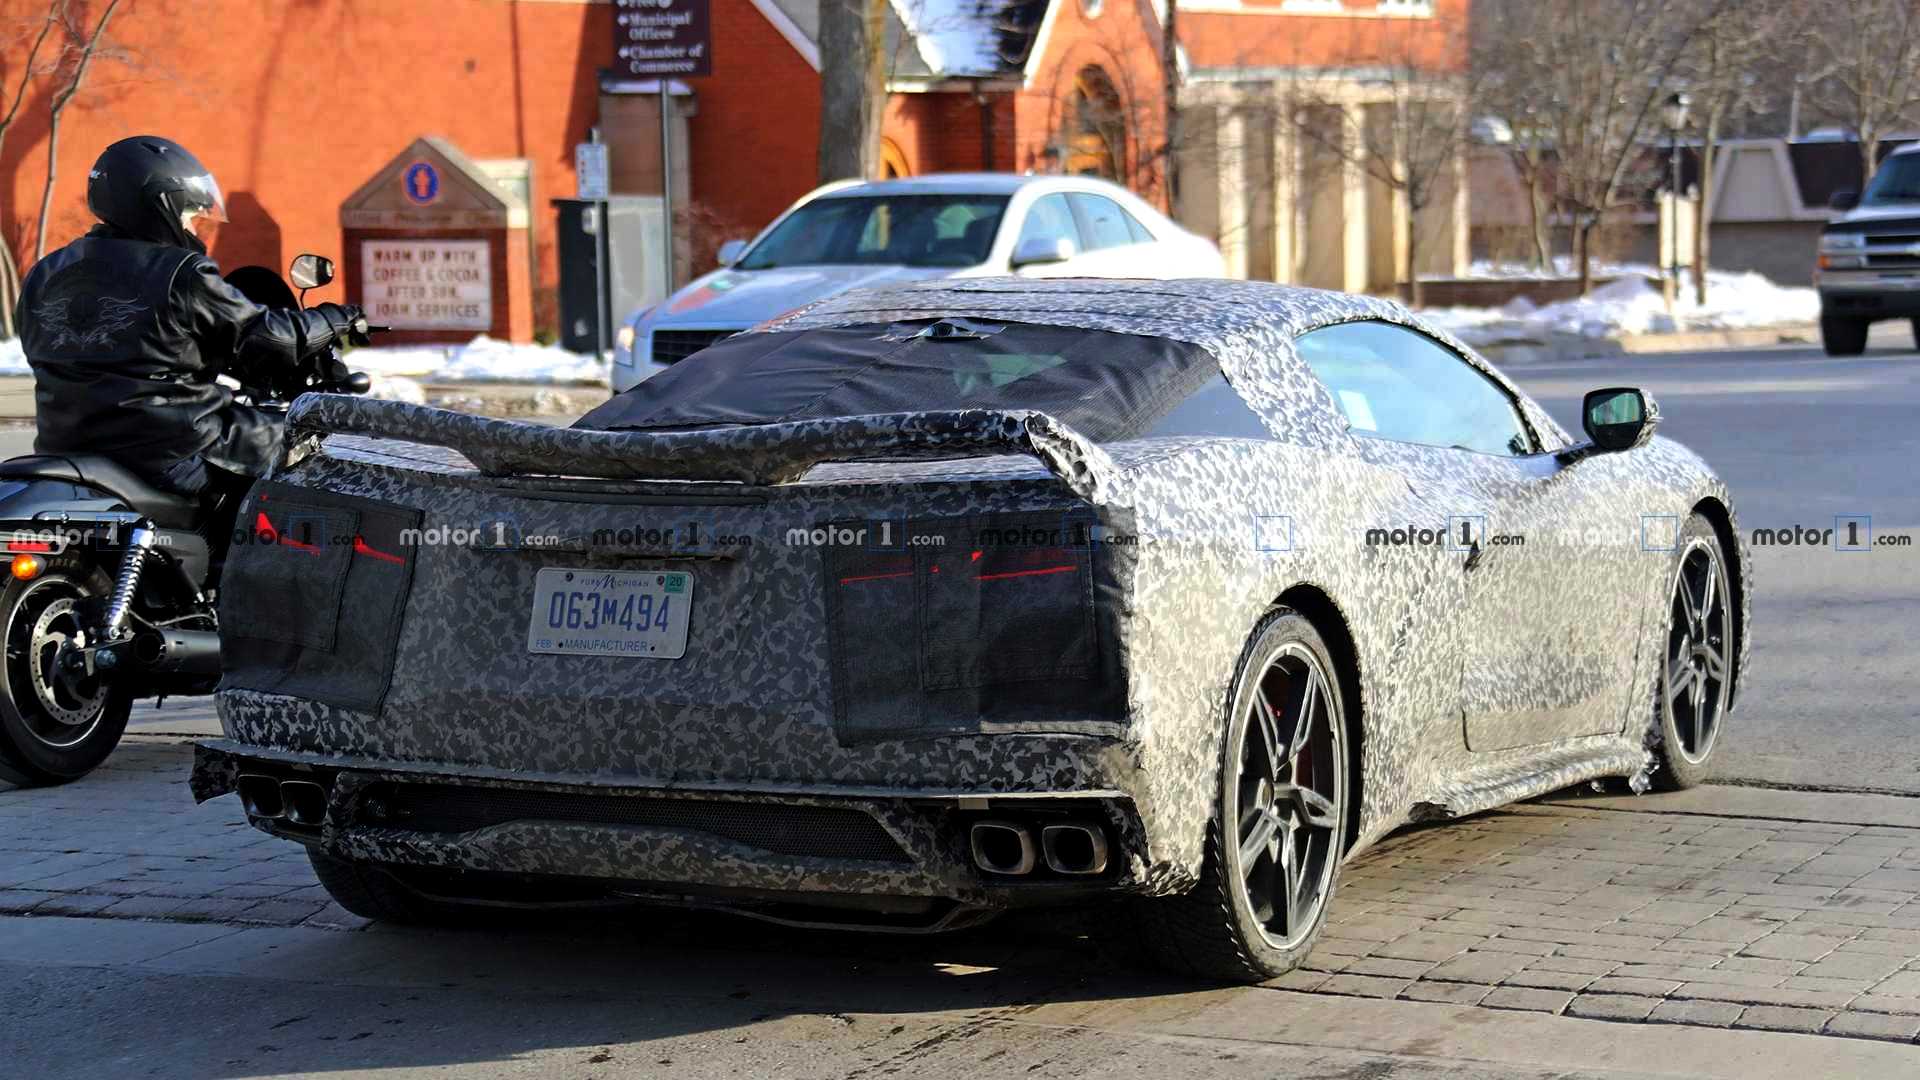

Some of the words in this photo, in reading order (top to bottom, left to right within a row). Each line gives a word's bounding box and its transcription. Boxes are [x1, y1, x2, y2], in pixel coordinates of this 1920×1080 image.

[629, 11, 691, 28] Municipal
[629, 27, 674, 40] Offices
[630, 45, 686, 59] Chamber
[688, 43, 703, 58] of
[630, 60, 696, 73] Commerce
[373, 250, 412, 262] WARM
[419, 250, 436, 262] UP
[444, 250, 477, 262] WITH
[373, 269, 420, 281] COFFEE
[440, 269, 480, 281] COCOA
[416, 304, 481, 317] SERVICES
[670, 576, 683, 587] 20
[548, 591, 670, 633] 063M494
[564, 639, 648, 652] MANUFACTURER
